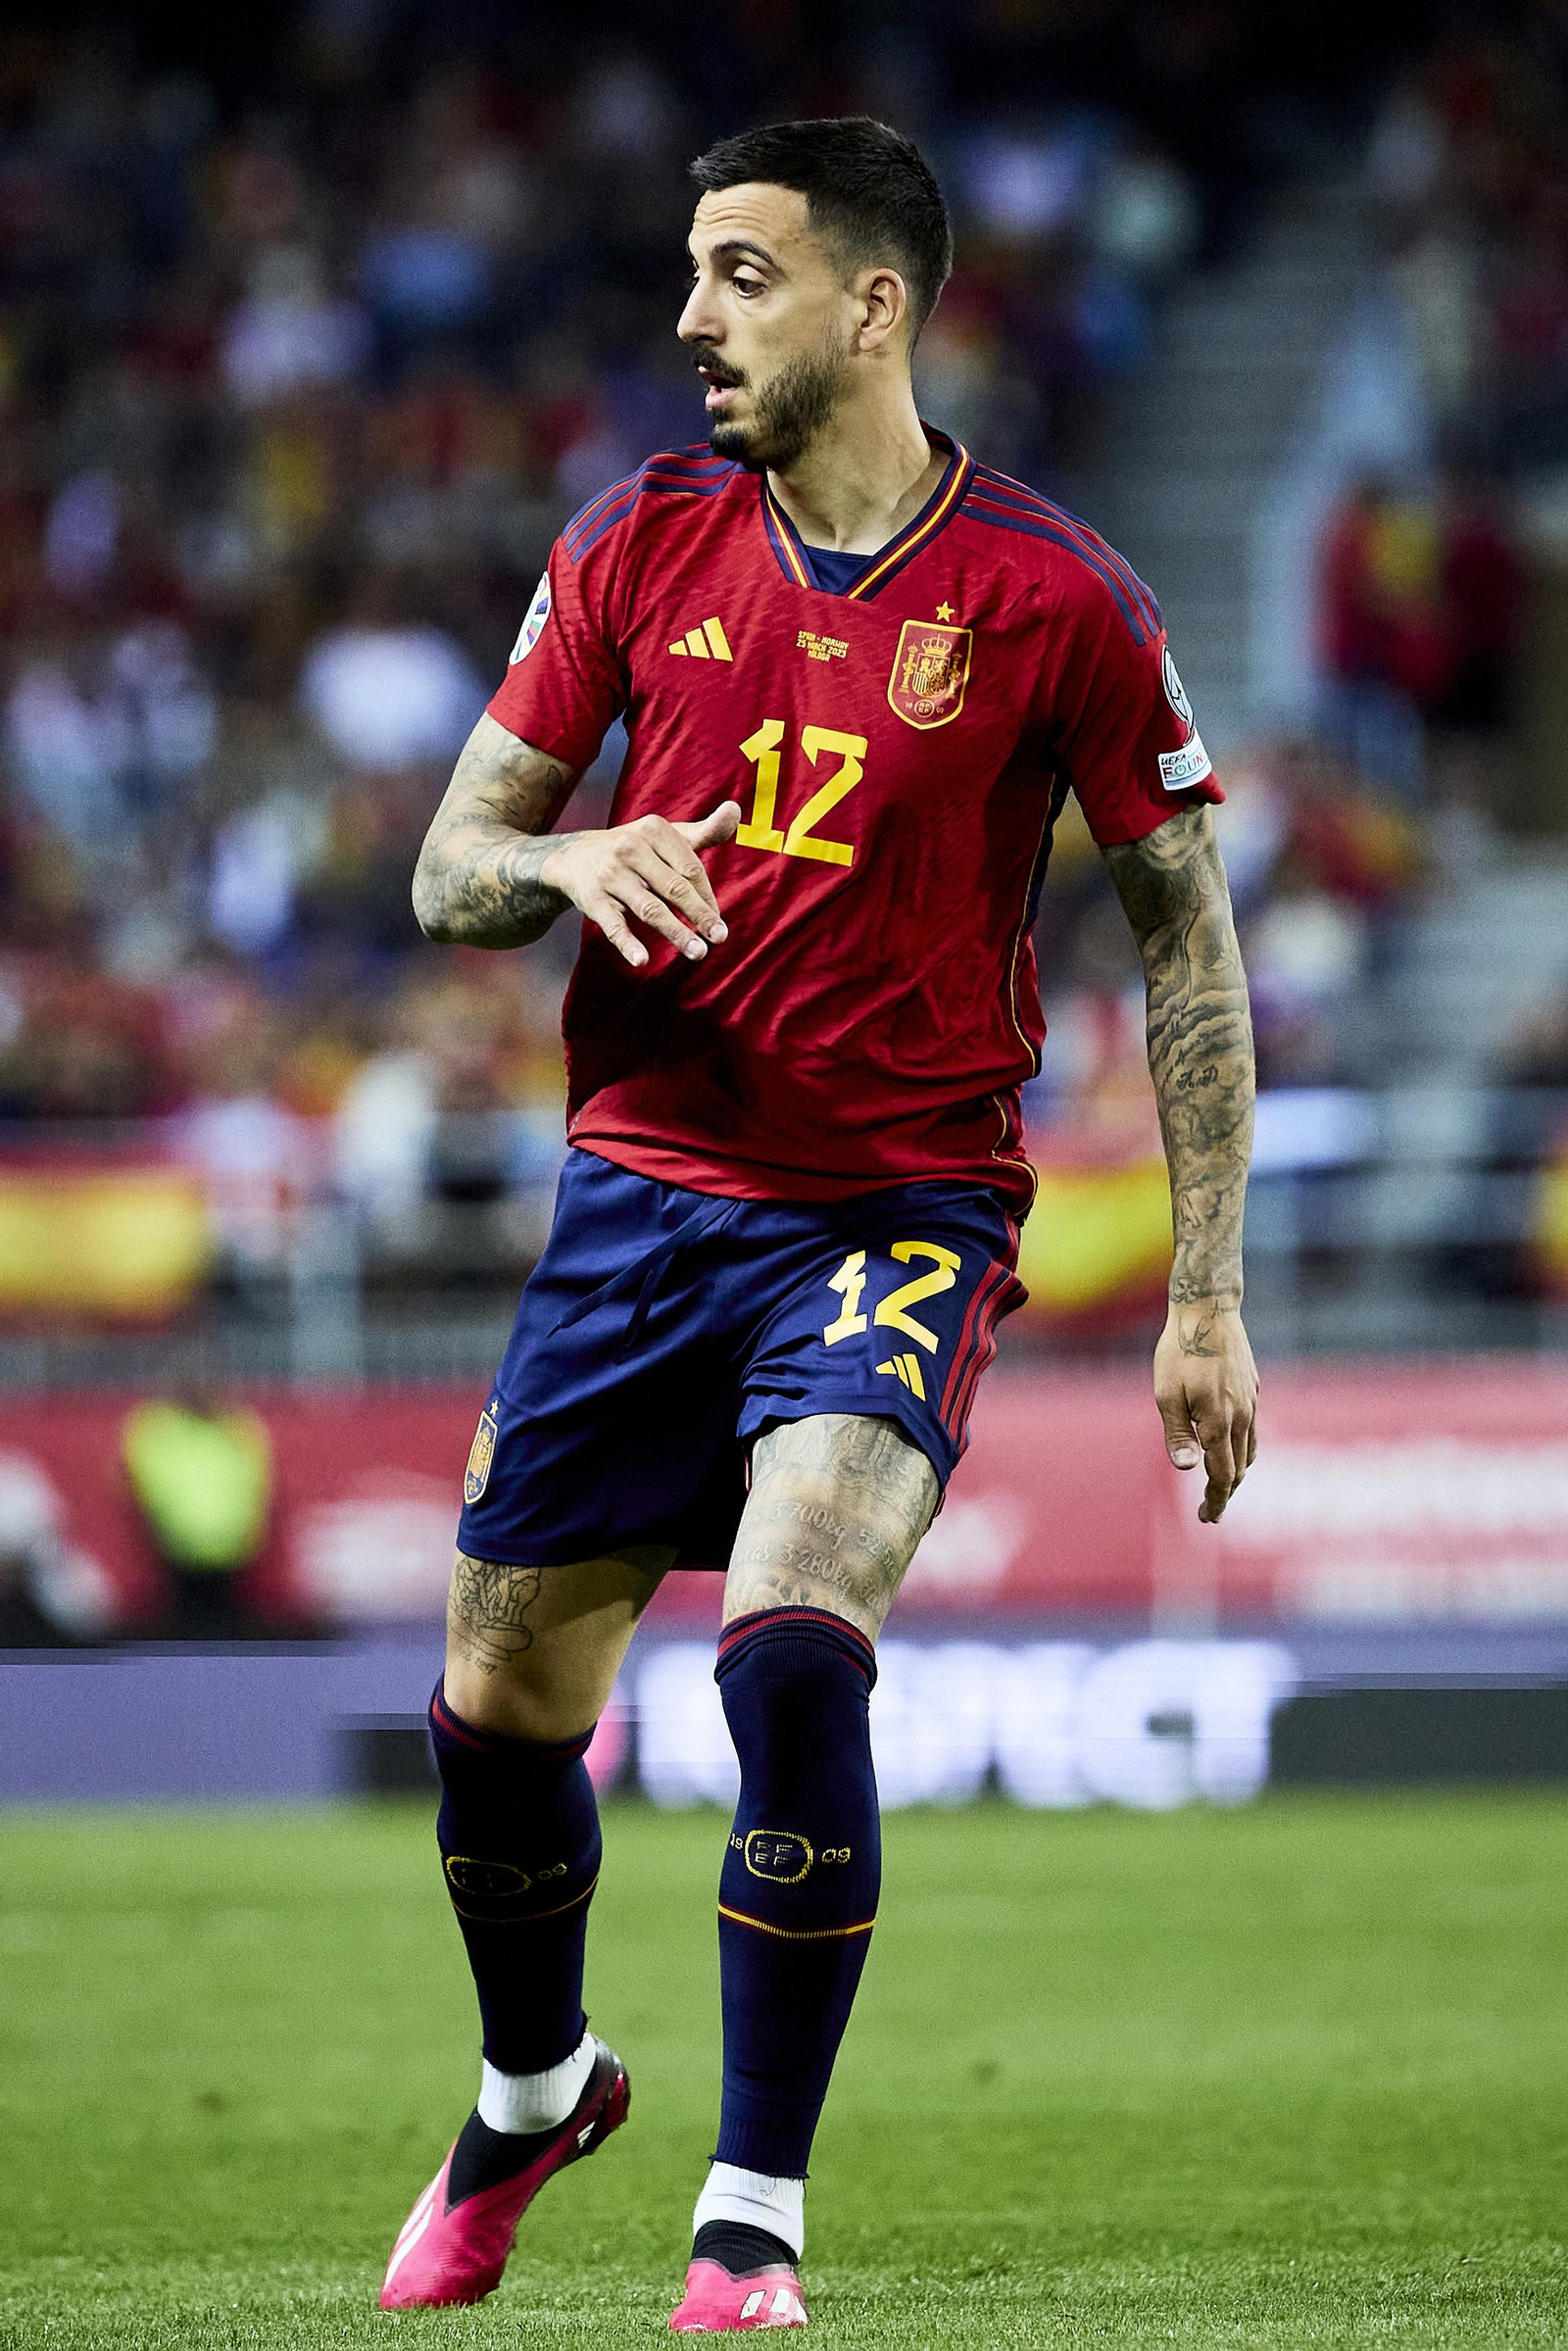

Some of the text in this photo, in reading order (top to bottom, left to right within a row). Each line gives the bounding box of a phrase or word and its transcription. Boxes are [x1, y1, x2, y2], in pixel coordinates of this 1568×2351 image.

[796, 638, 847, 659] 25 MARCH 2023
[821, 636, 850, 650] NORWAY
[1161, 754, 1186, 765] UEFA
[736, 718, 868, 867] 12
[823, 1241, 961, 1355] 12
[729, 1833, 744, 1850] 19
[821, 1846, 851, 1864] 09
